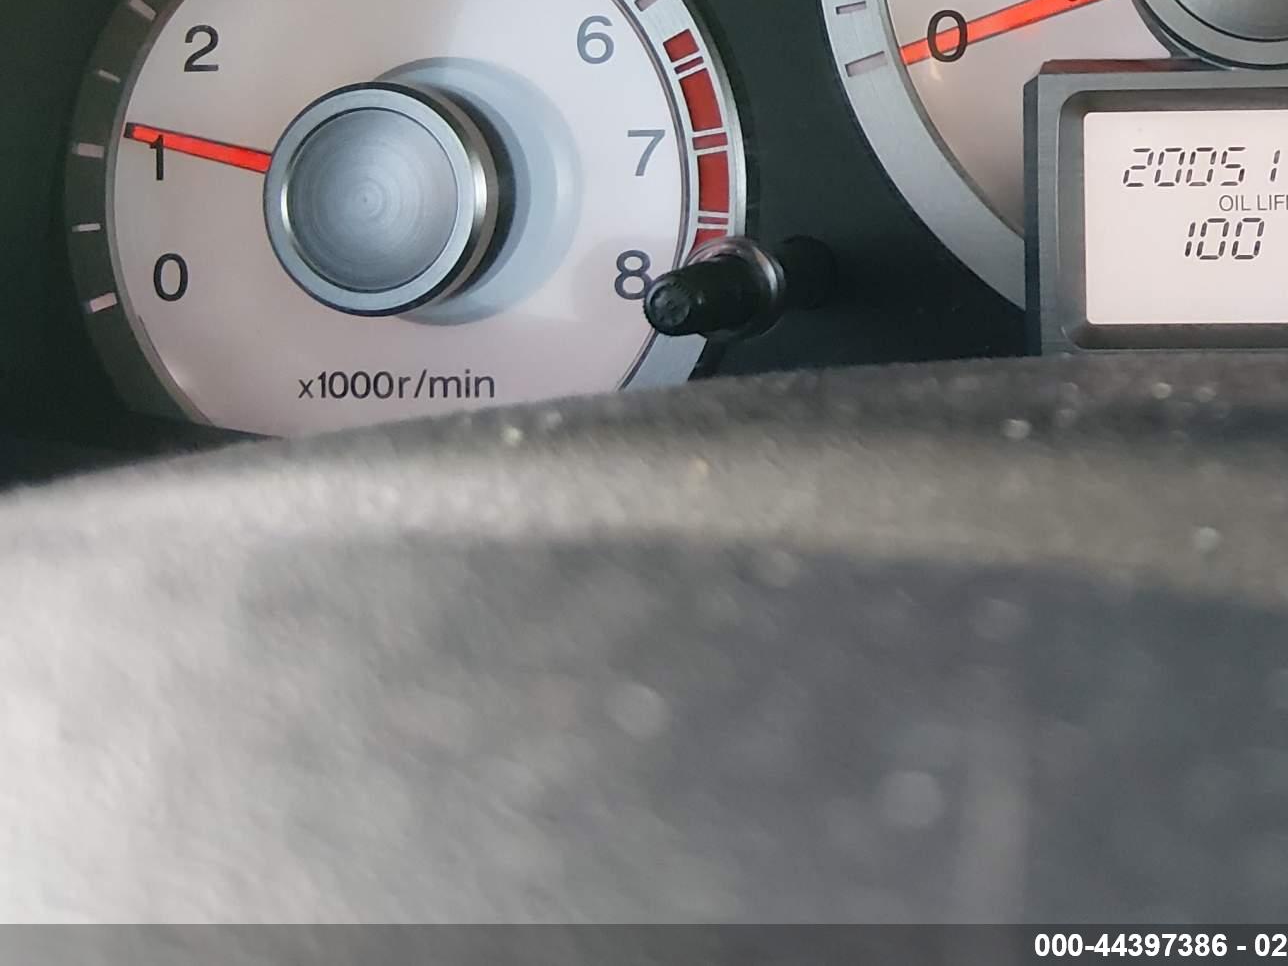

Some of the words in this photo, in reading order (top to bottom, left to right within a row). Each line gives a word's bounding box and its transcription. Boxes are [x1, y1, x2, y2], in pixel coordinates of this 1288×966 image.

[184, 25, 220, 73] 2
[577, 15, 615, 65] 6
[927, 10, 967, 63] 0
[148, 137, 165, 181] 1
[628, 129, 666, 177] 7
[1219, 194, 1252, 212] OIL
[1184, 217, 1264, 260] 100
[154, 254, 188, 302] 0
[615, 250, 653, 300] 8
